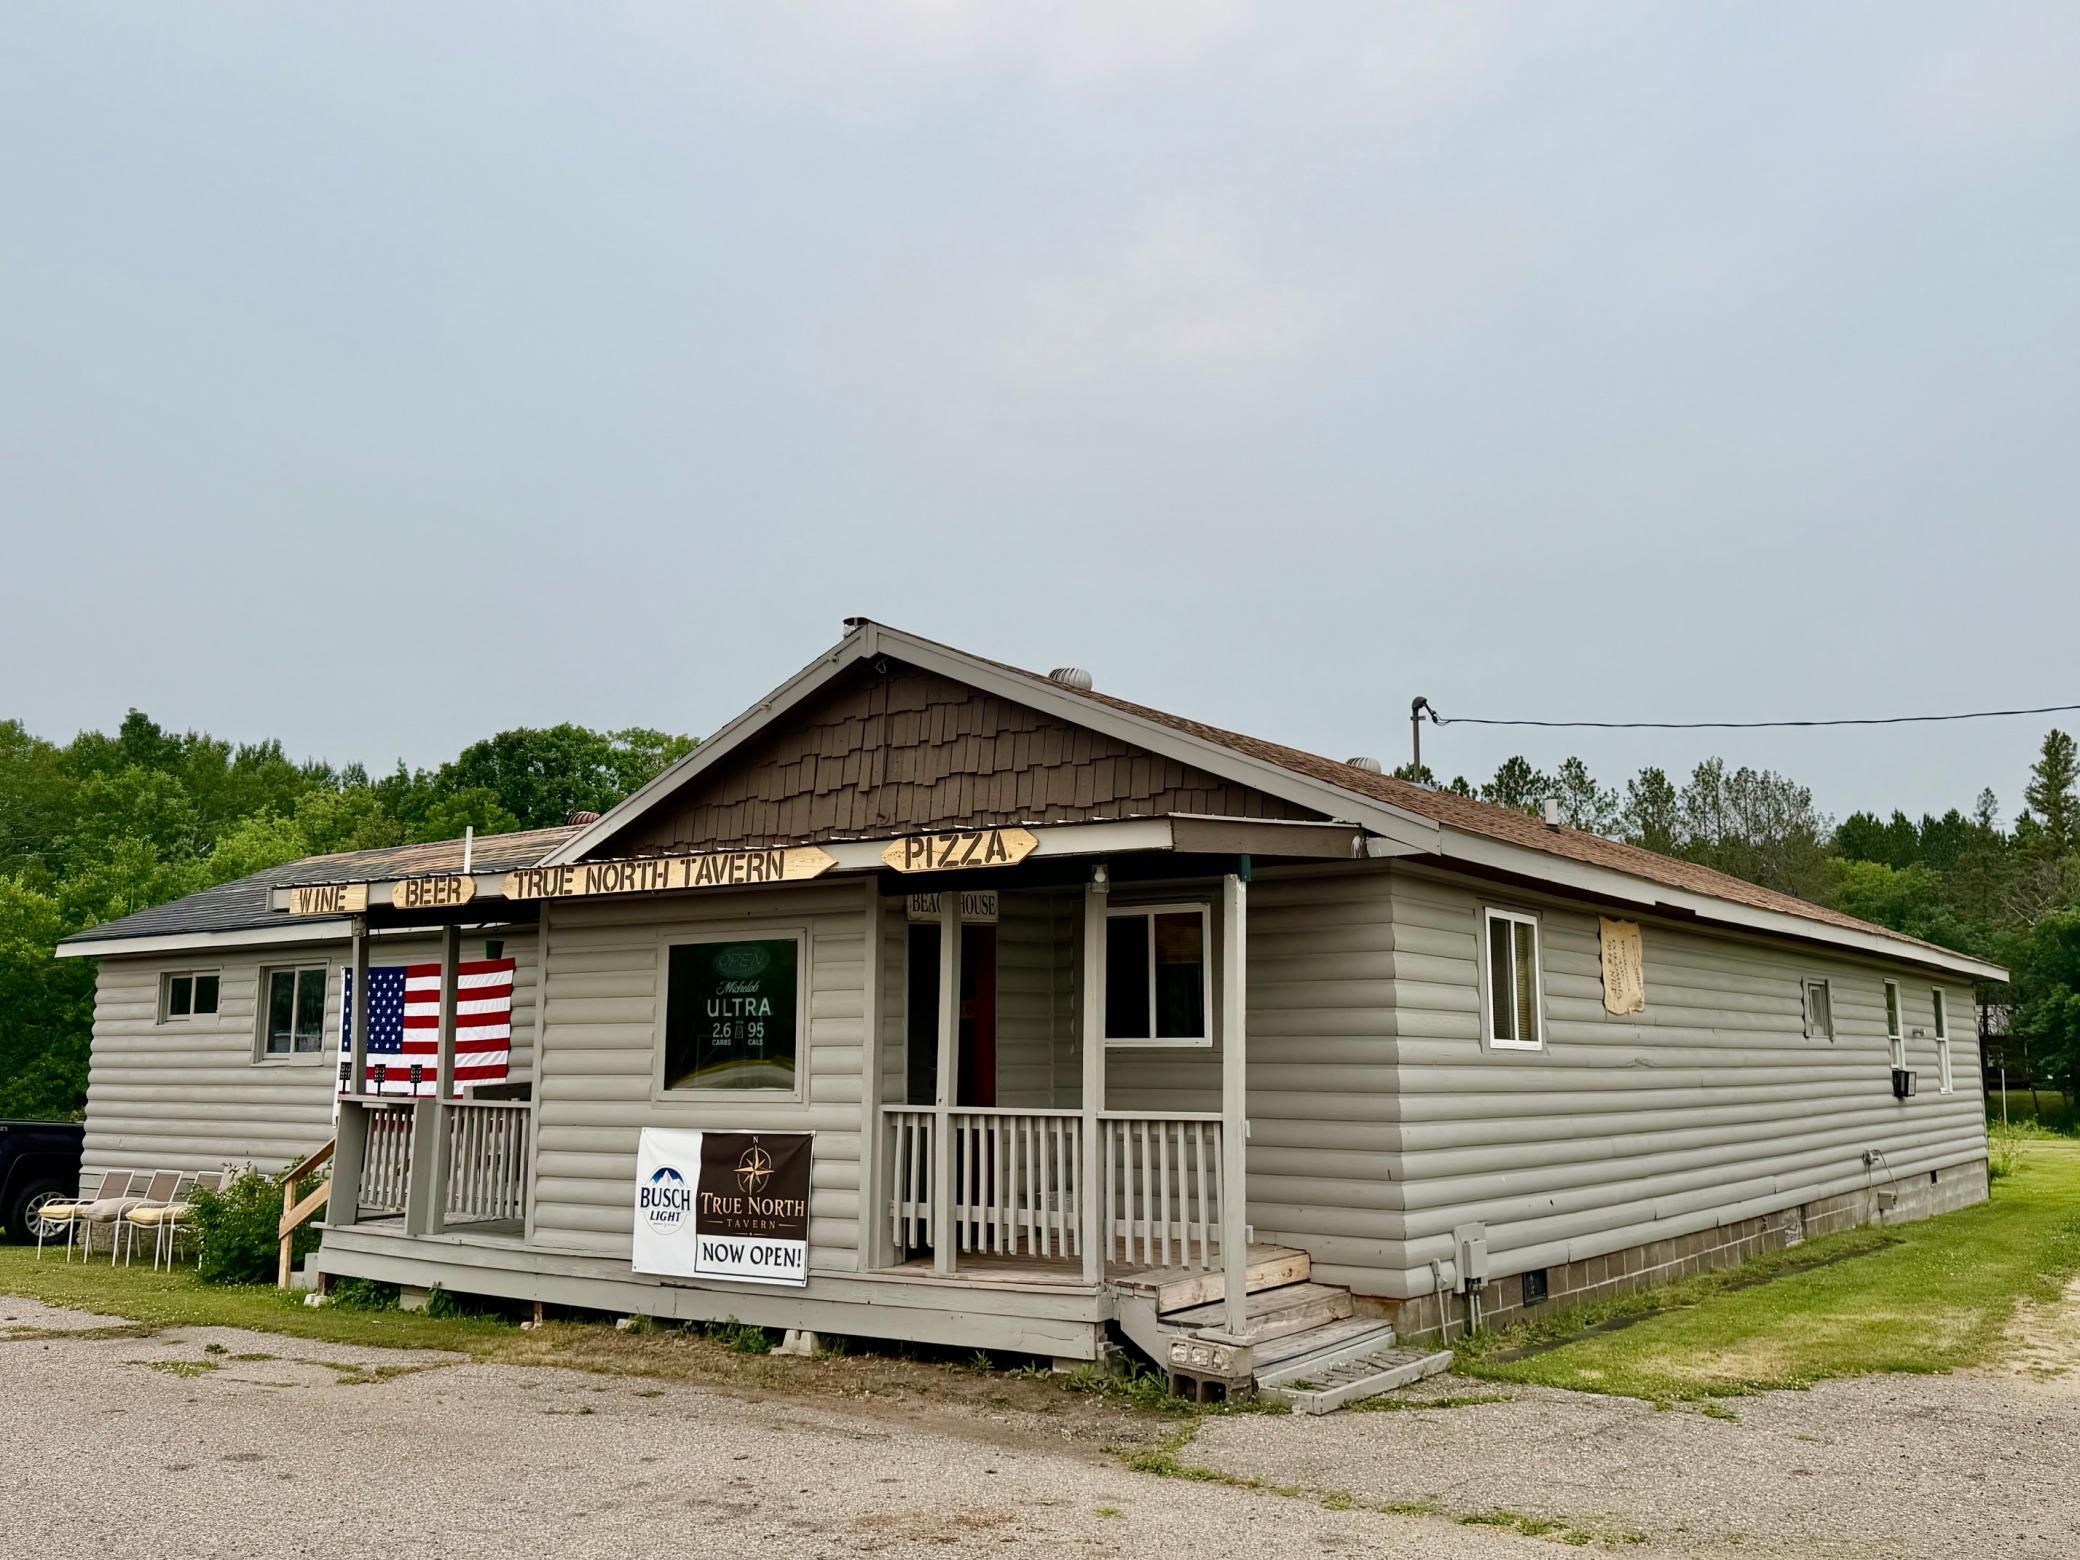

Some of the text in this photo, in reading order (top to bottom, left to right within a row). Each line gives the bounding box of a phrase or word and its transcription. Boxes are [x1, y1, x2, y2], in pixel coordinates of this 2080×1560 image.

[905, 830, 1007, 869] PIZZA
[513, 850, 785, 898] TRUE NORTH TAVERN
[299, 884, 348, 913] WINE
[405, 876, 462, 907] BEER
[716, 980, 760, 996] Michelob
[706, 997, 773, 1018] ULTRA
[712, 1022, 765, 1038] 2.6 95
[752, 1135, 759, 1144] N
[640, 1186, 691, 1211] BUSCH
[650, 1210, 681, 1223] LIGHT
[726, 1218, 777, 1230] TAVERN
[702, 1242, 801, 1268] NOW OPEN!
